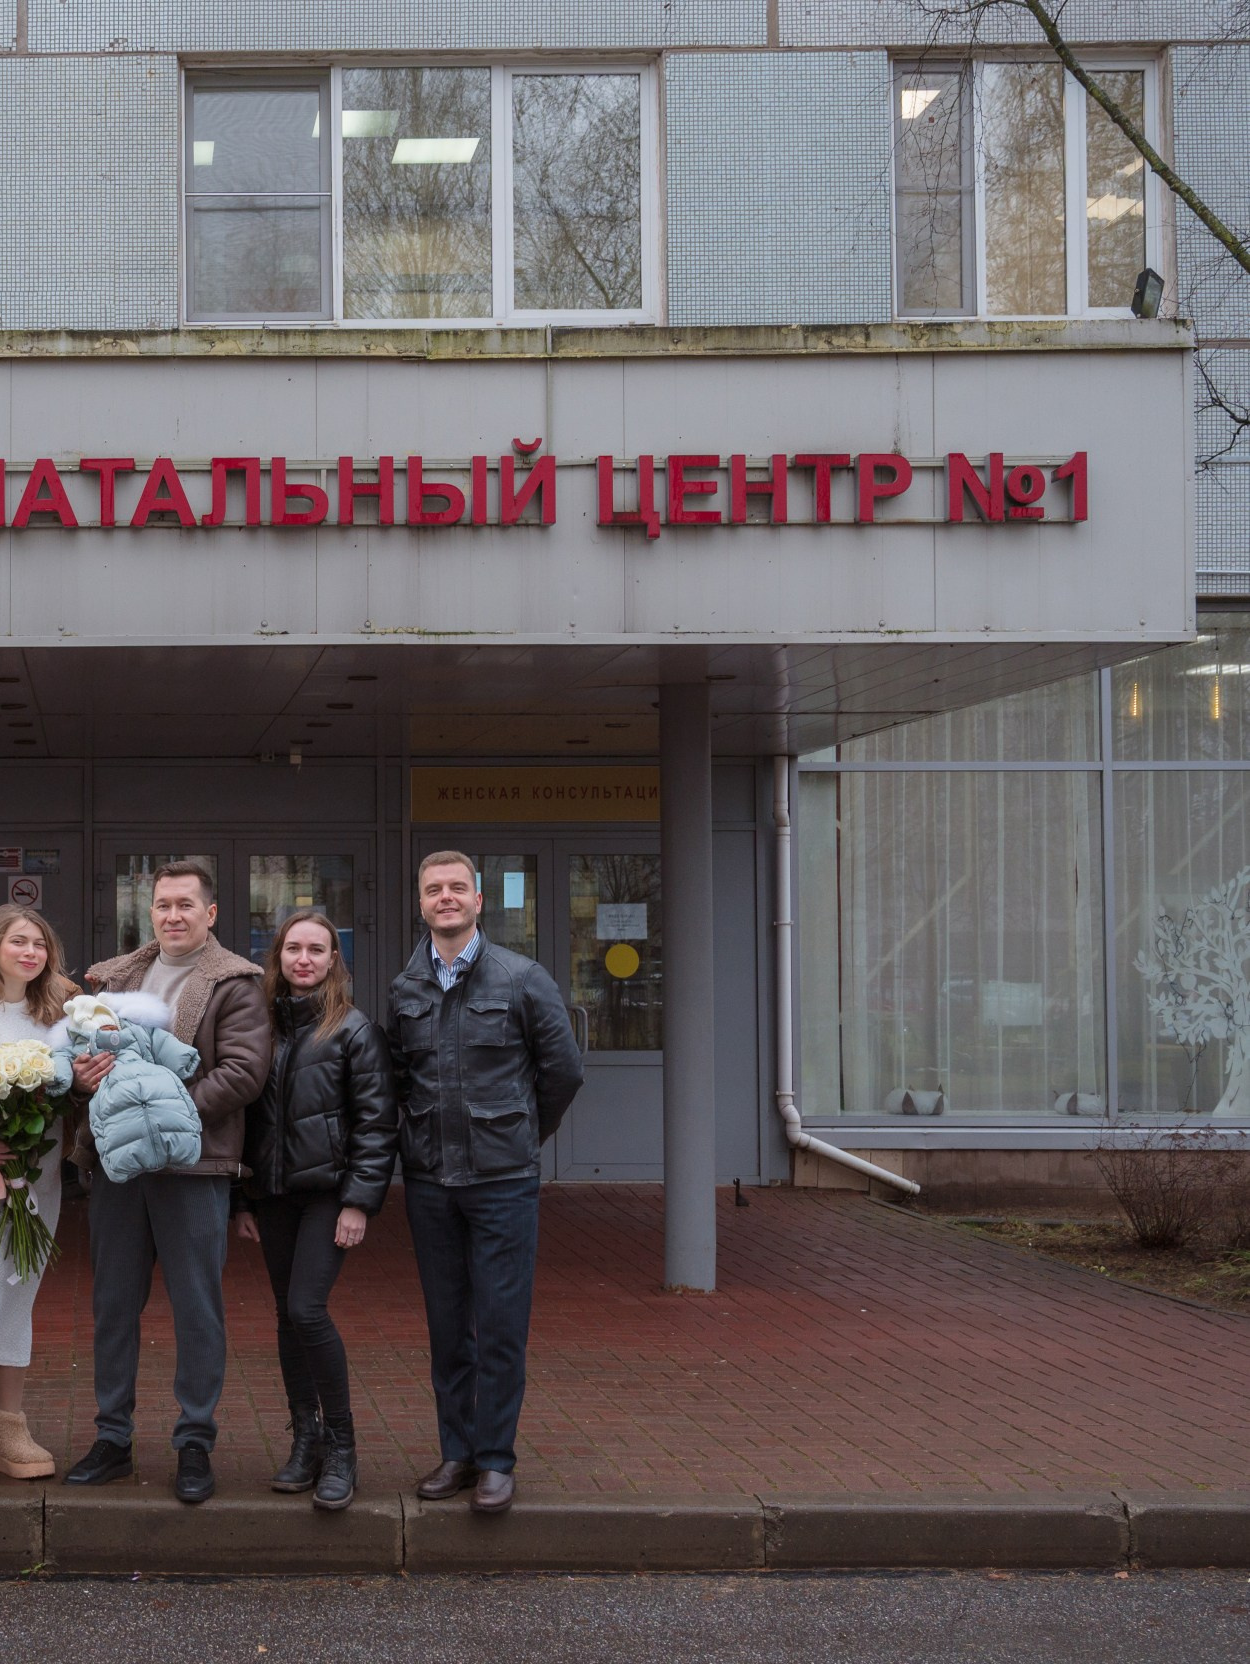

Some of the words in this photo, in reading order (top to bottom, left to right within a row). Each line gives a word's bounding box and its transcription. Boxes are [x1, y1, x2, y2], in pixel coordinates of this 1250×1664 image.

[597, 455, 913, 539] ЦЕНТР
[946, 451, 1088, 524] №1
[437, 786, 521, 800] ЖЕНСКАЯ
[532, 785, 659, 801] КОНСУЛЬТАЦИ
